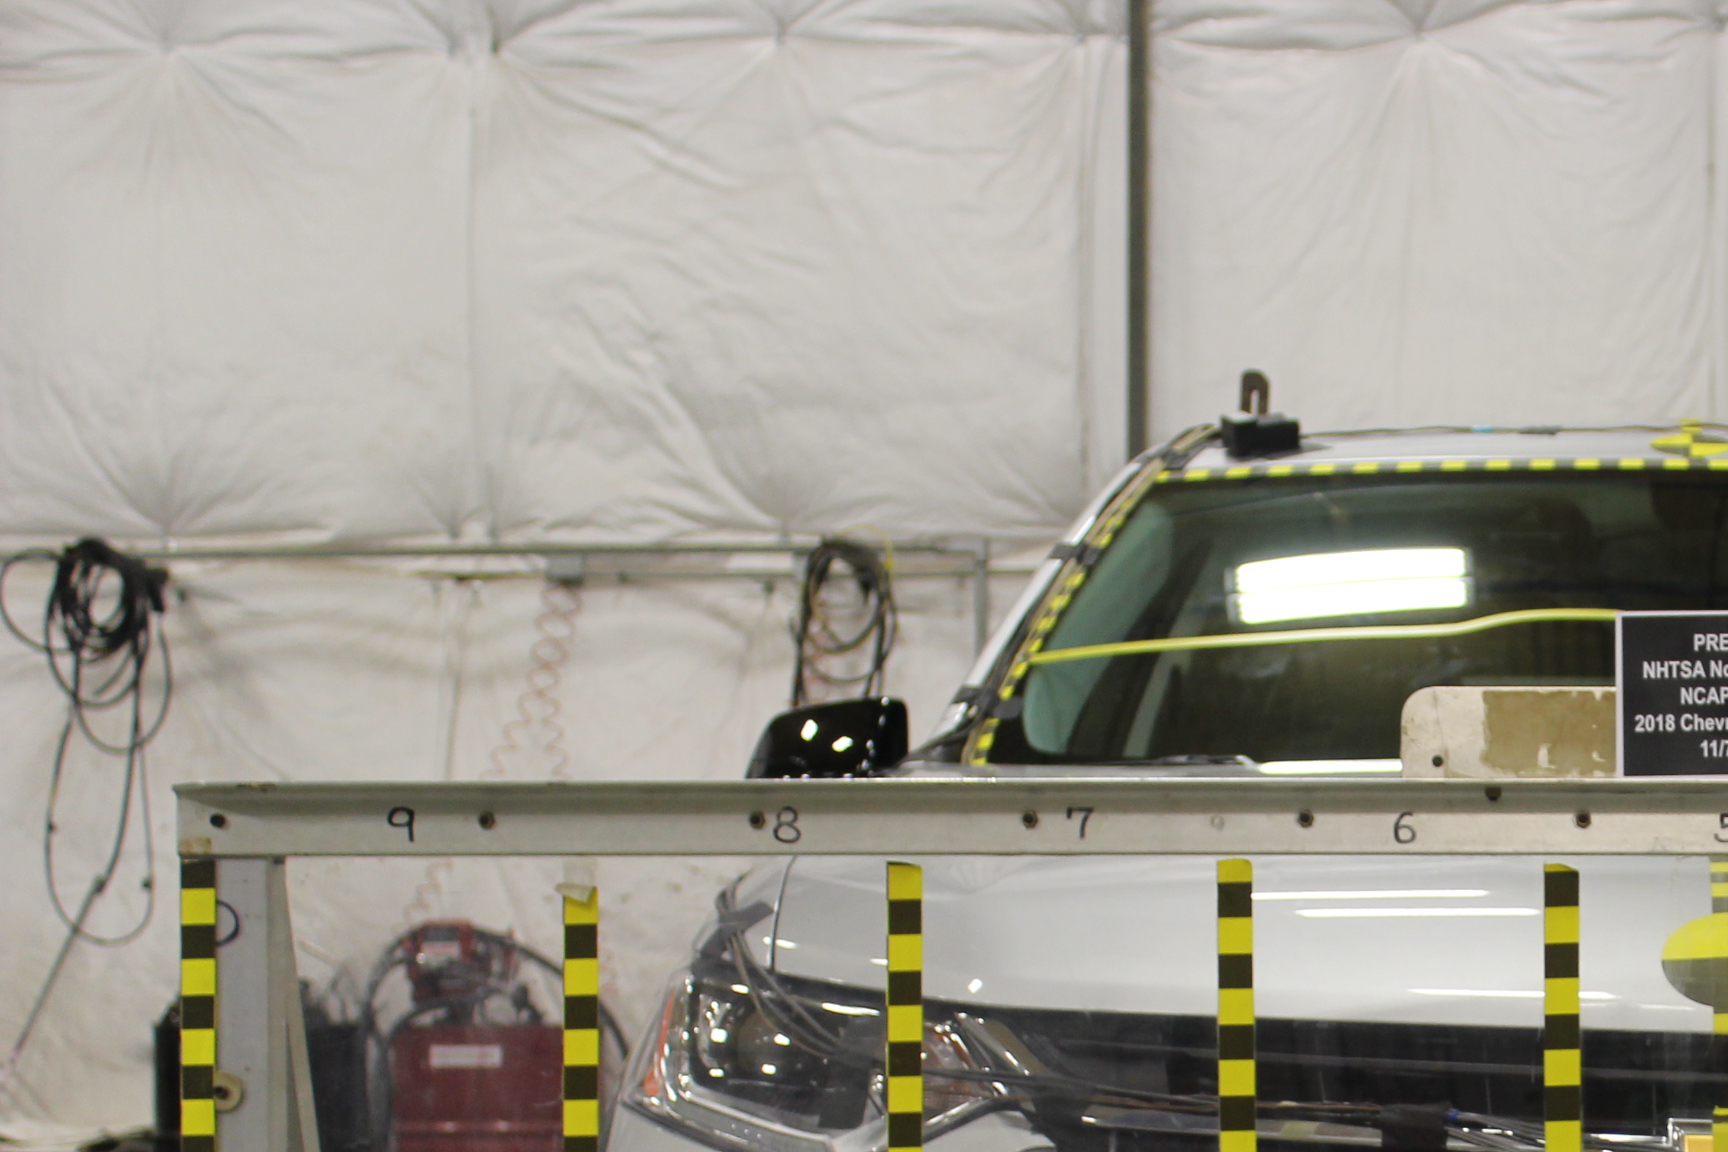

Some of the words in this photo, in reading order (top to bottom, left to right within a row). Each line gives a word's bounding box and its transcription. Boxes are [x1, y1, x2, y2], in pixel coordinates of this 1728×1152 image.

[1642, 661, 1705, 679] NHTSA
[1634, 714, 1676, 732] 2018
[387, 806, 416, 842] 9
[773, 805, 801, 844] 8
[1066, 806, 1095, 839] 7
[1393, 811, 1417, 844] 6
